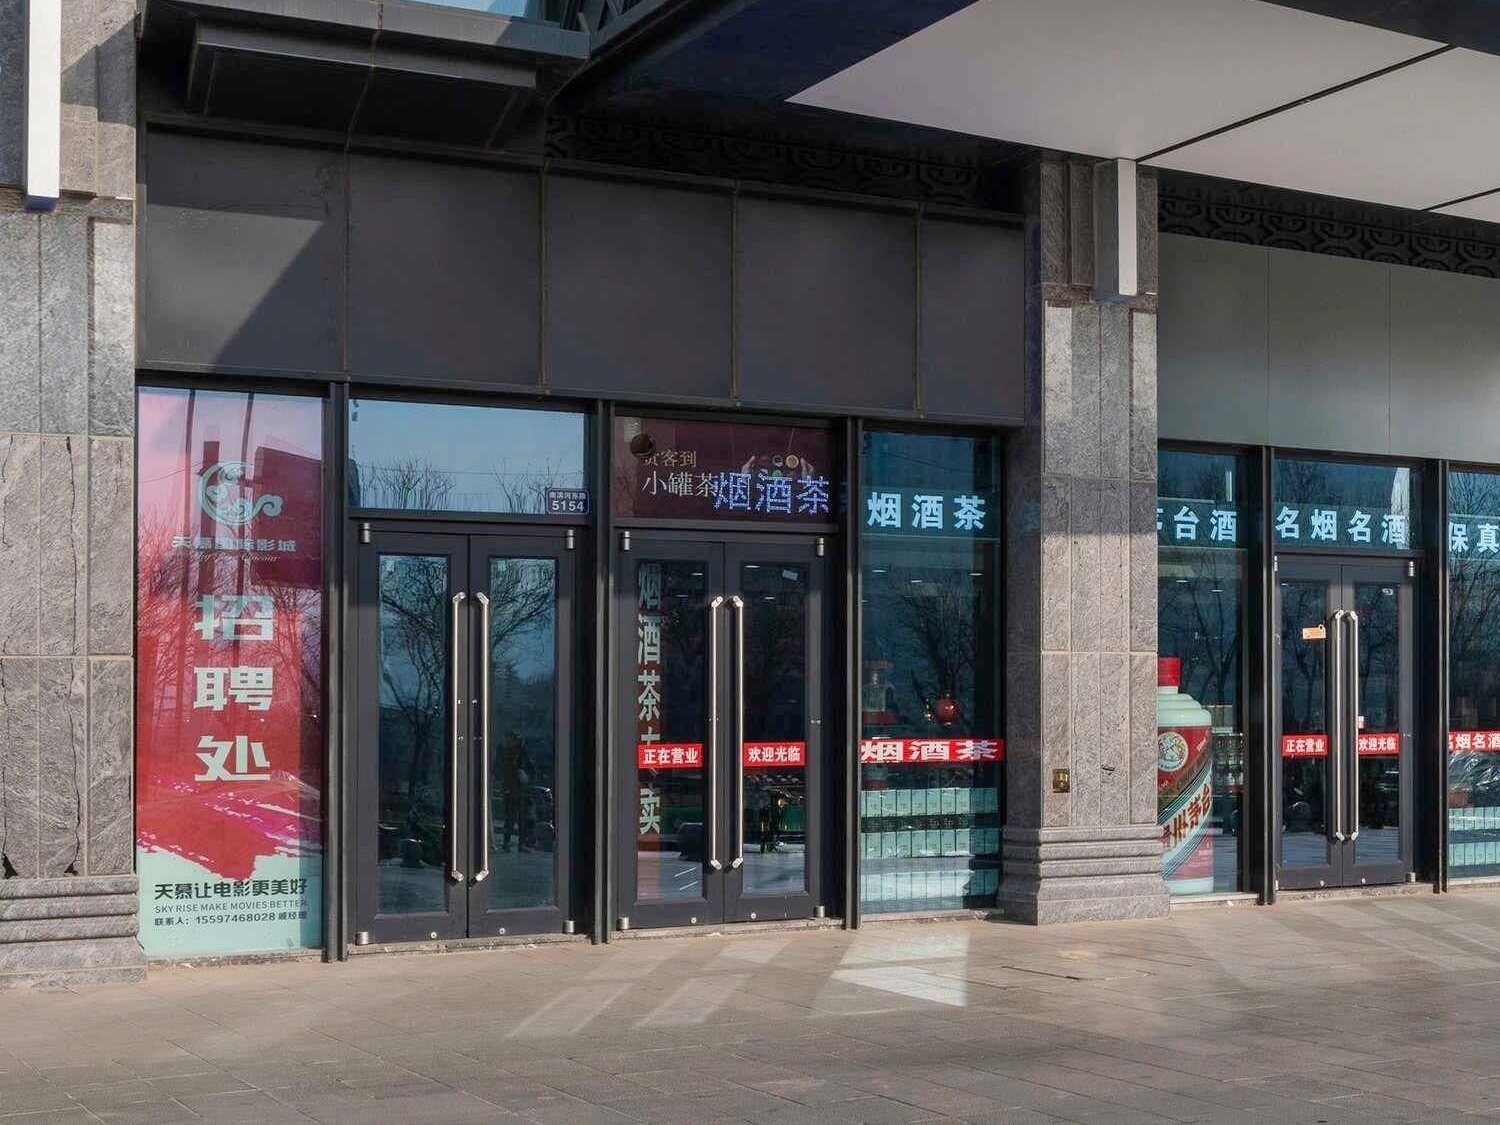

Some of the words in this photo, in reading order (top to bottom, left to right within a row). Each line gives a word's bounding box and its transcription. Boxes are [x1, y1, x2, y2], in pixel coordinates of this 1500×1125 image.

[641, 470, 719, 498] 小罐茶
[712, 472, 830, 515] 烟酒茶
[552, 500, 585, 512] 5154
[867, 491, 986, 530] 烟酒茶
[1275, 506, 1407, 544] 名烟名酒
[193, 594, 274, 781] 招聘处
[860, 739, 998, 763] 烟酒茶
[1285, 738, 1325, 753] 正在营业
[1358, 736, 1397, 751] 欢迎光临
[643, 746, 699, 764] 正在营业
[748, 746, 801, 762] 欢迎光临
[155, 904, 175, 914] SKY
[176, 904, 198, 913] RISE
[200, 902, 227, 912] MAKE
[230, 900, 268, 910] MOVIES
[269, 899, 307, 908] BETTER
[195, 912, 276, 925] 15597468028
